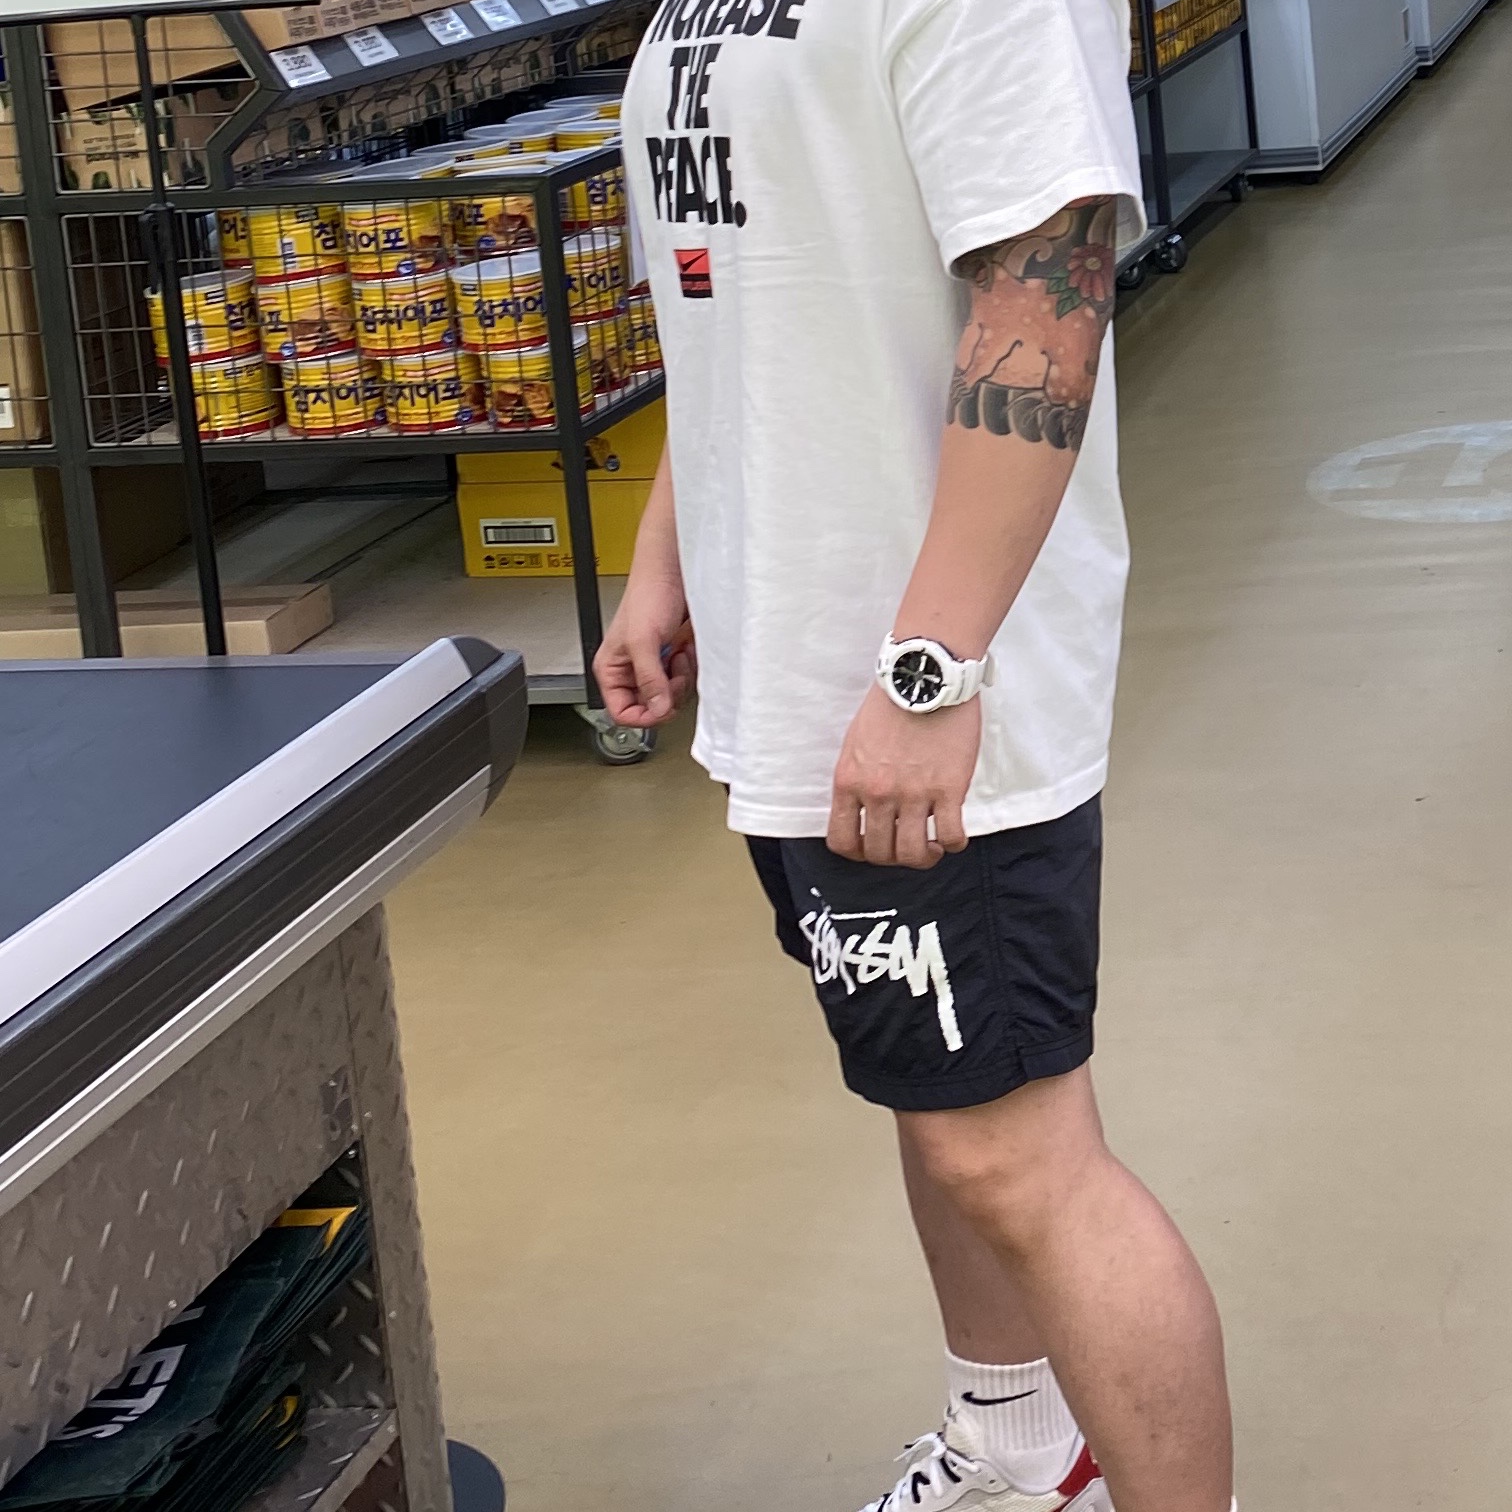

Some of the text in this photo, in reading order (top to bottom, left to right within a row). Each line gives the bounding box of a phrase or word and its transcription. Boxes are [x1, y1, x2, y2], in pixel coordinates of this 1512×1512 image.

[667, 43, 724, 131] THE
[646, 135, 747, 228] PEACE.
[360, 298, 449, 333] 참치어포
[474, 291, 545, 328] 참치어
